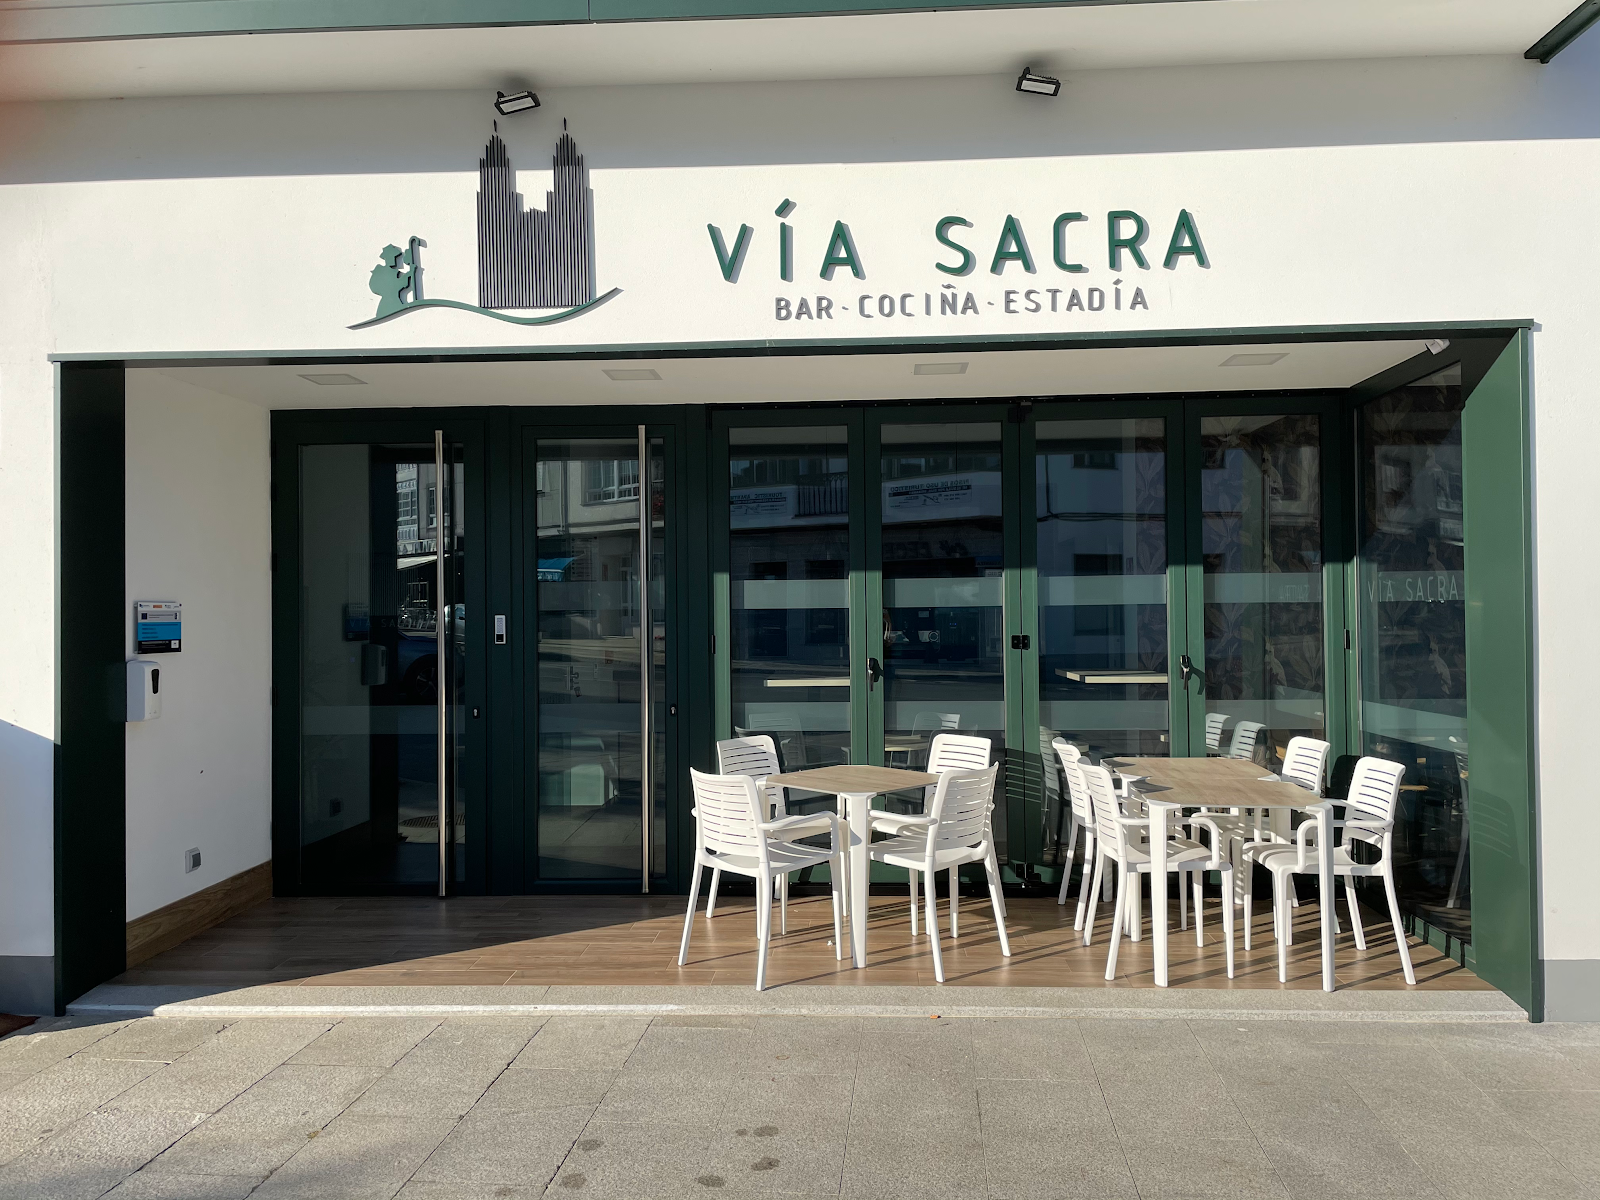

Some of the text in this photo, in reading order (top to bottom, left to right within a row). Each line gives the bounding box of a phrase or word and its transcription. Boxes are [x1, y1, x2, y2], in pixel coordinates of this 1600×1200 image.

[707, 199, 1208, 281] VÍA SACRA
[775, 277, 1149, 321] BAR COCIÑA ESTADÍA
[1405, 574, 1459, 603] SACRA
